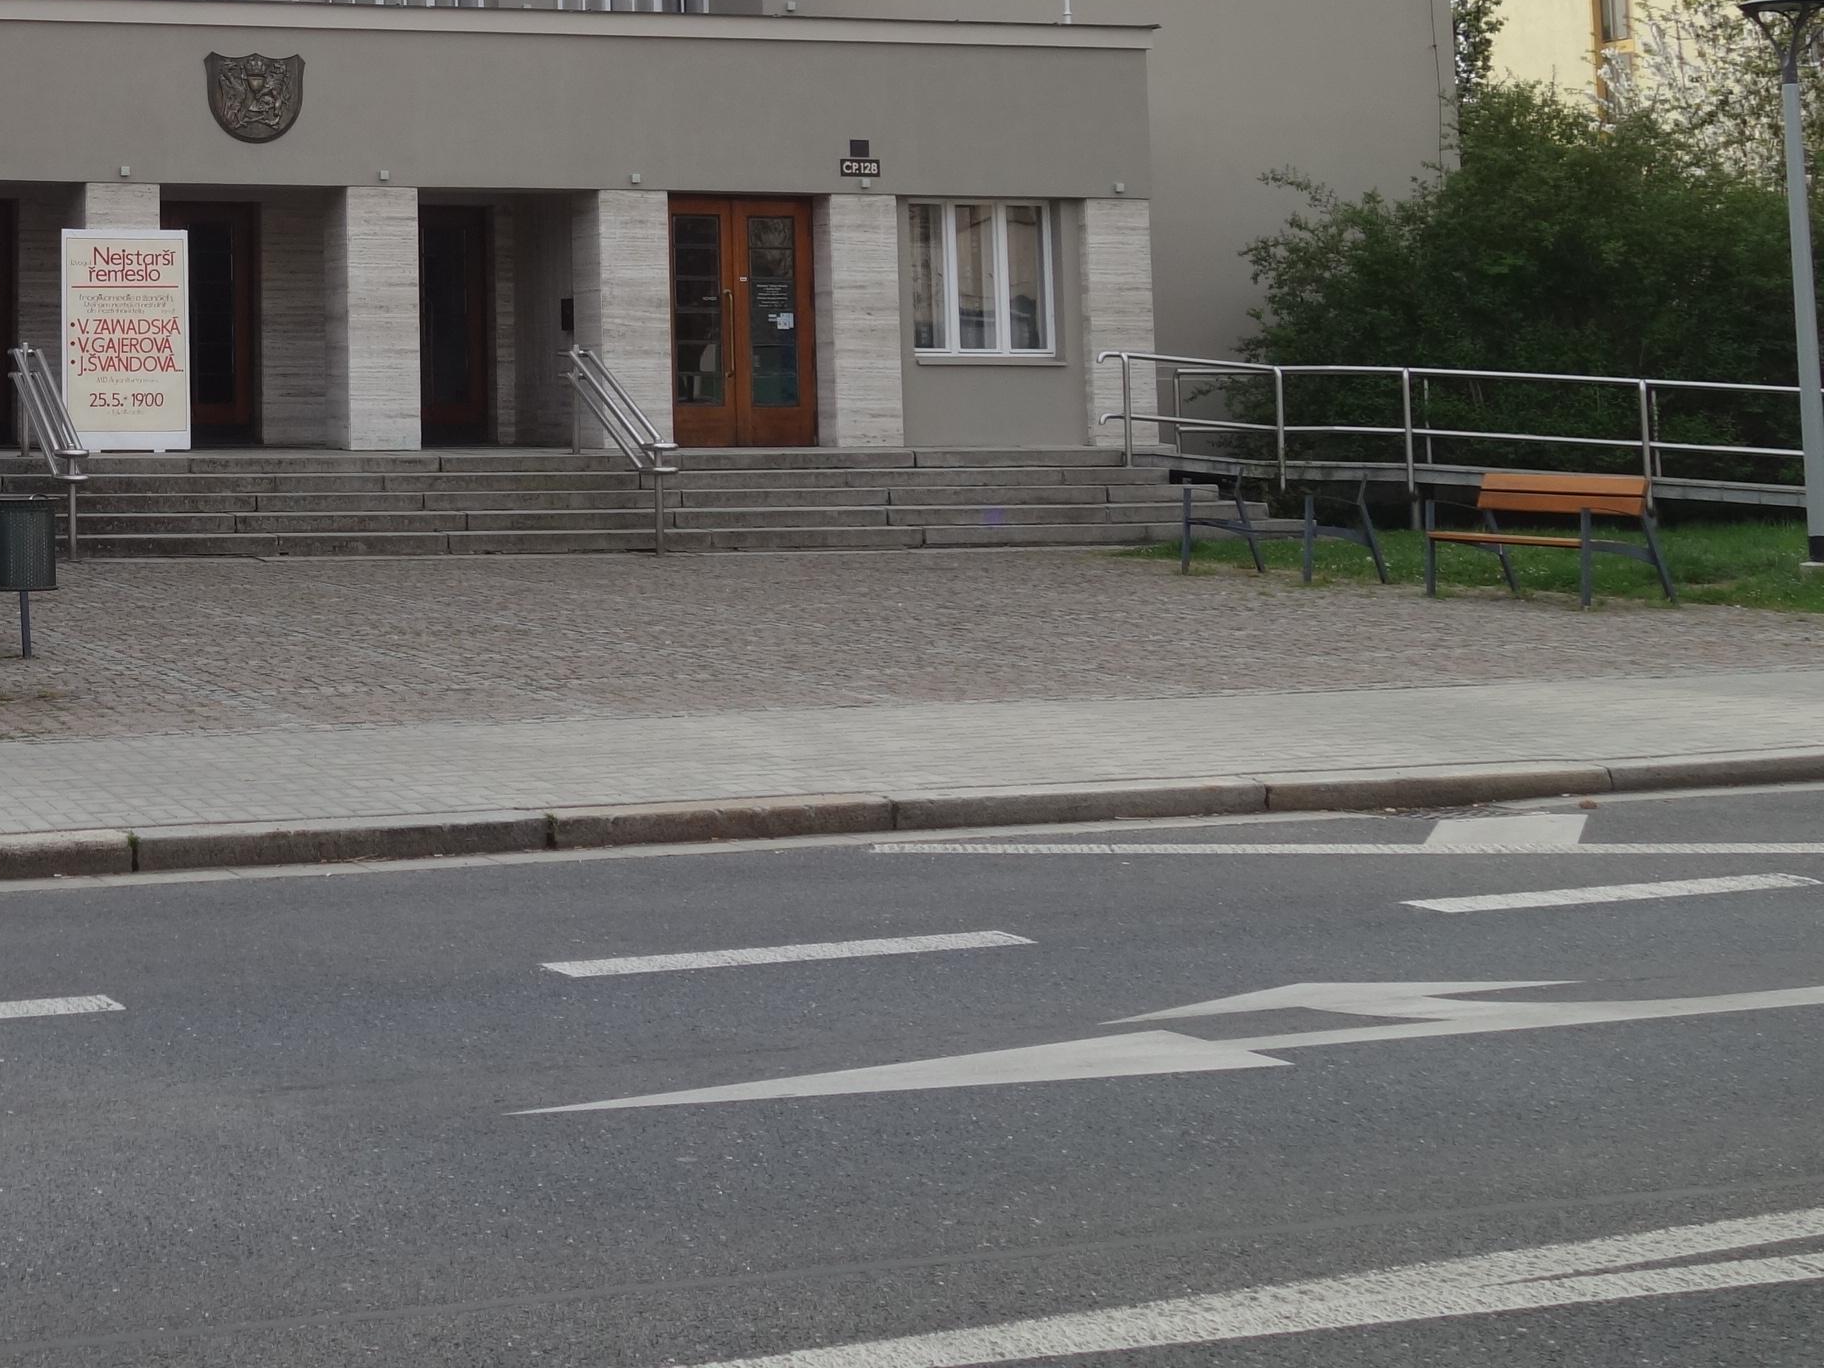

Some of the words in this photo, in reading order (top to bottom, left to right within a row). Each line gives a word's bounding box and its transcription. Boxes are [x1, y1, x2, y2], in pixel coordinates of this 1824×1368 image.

[93, 246, 176, 271] Nejstarší
[88, 264, 161, 282] řemeslo
[93, 316, 181, 335] ZAWADSKÁ
